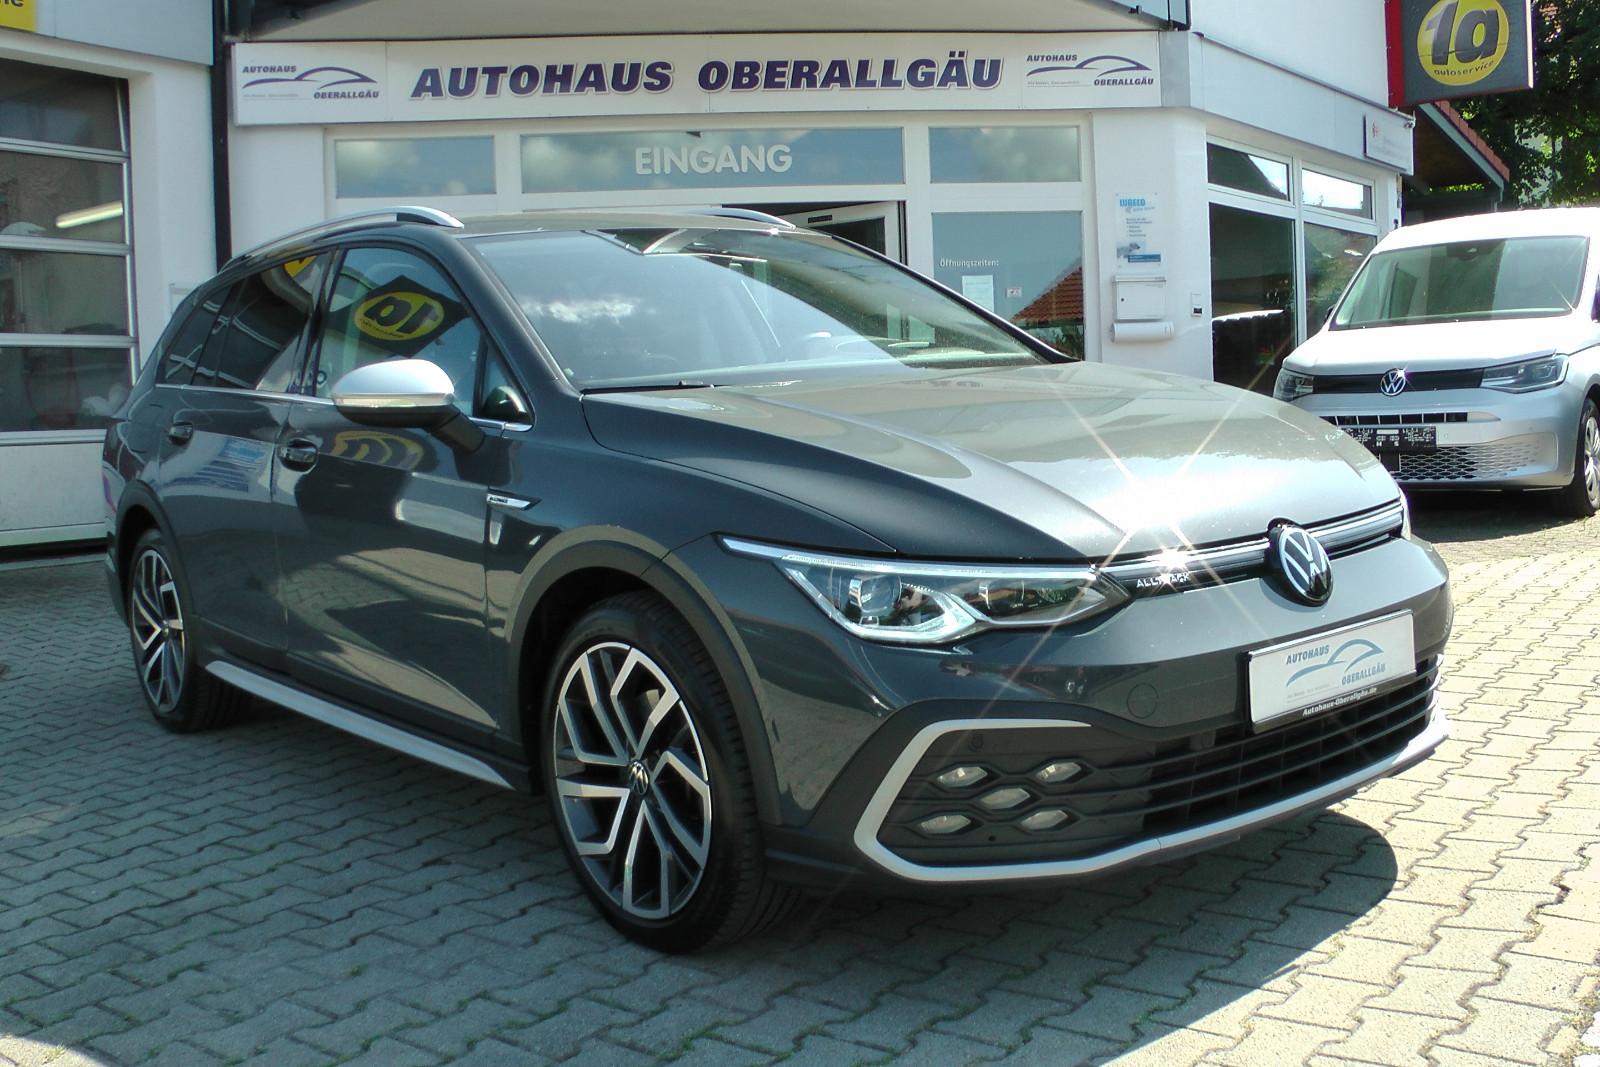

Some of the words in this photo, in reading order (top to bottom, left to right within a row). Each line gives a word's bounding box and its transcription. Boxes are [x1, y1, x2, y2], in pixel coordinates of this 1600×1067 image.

[1424, 0, 1499, 65] 1a
[1026, 54, 1078, 62] AUTOHAUS
[242, 65, 297, 73] AUTOHAUS
[410, 61, 673, 99] AUTOHAUS
[698, 50, 1003, 92] OBERALLGÄU
[1434, 60, 1495, 76] autoservice
[1093, 77, 1154, 86] OBERALLGÄU
[313, 89, 380, 99] OBERALLGÄU
[635, 144, 793, 175] EINGANG
[1136, 571, 1189, 588] ALLTACK
[1286, 645, 1330, 665] AUTOHAUS
[1341, 662, 1386, 686] OBERALLGÄU
